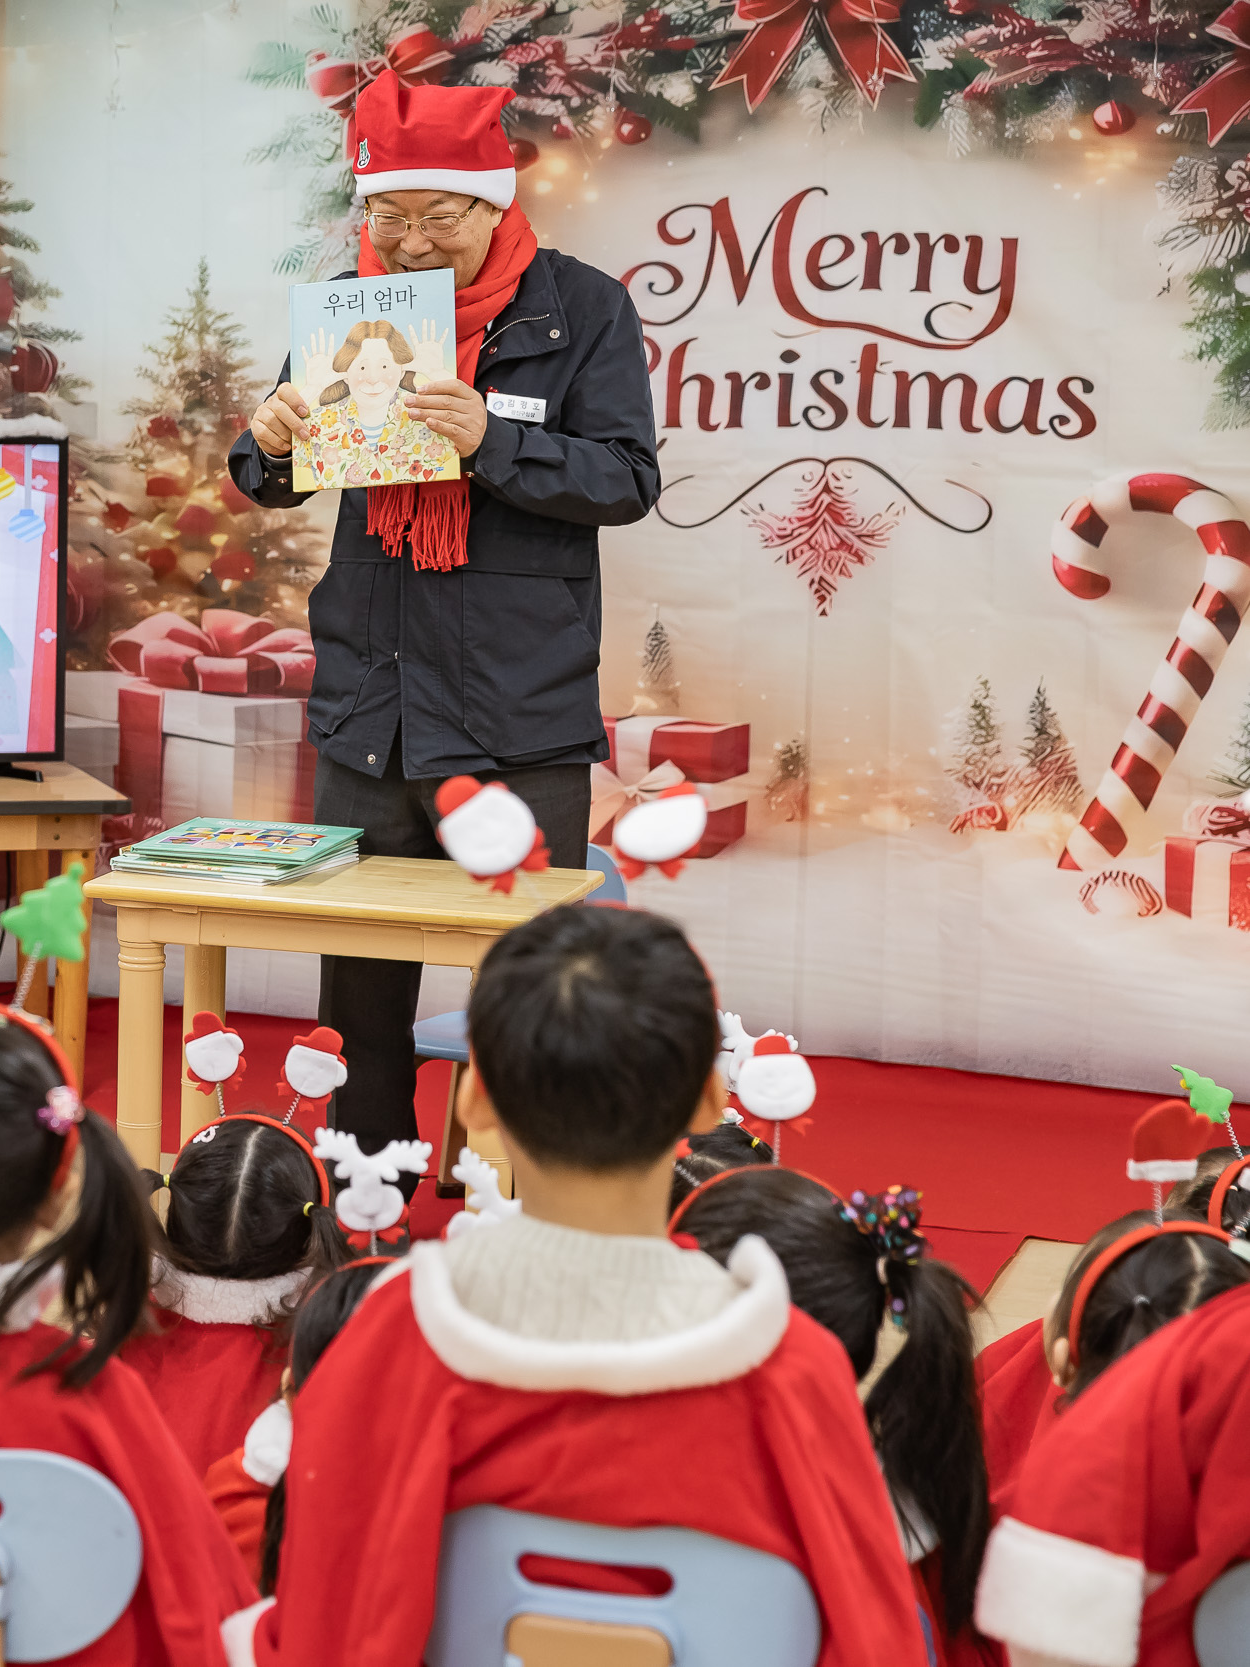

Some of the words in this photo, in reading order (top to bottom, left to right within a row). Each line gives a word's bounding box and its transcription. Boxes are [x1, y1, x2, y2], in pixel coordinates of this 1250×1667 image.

[323, 289, 364, 317] 우리
[374, 284, 418, 312] 엄마
[620, 186, 1020, 350] Merry
